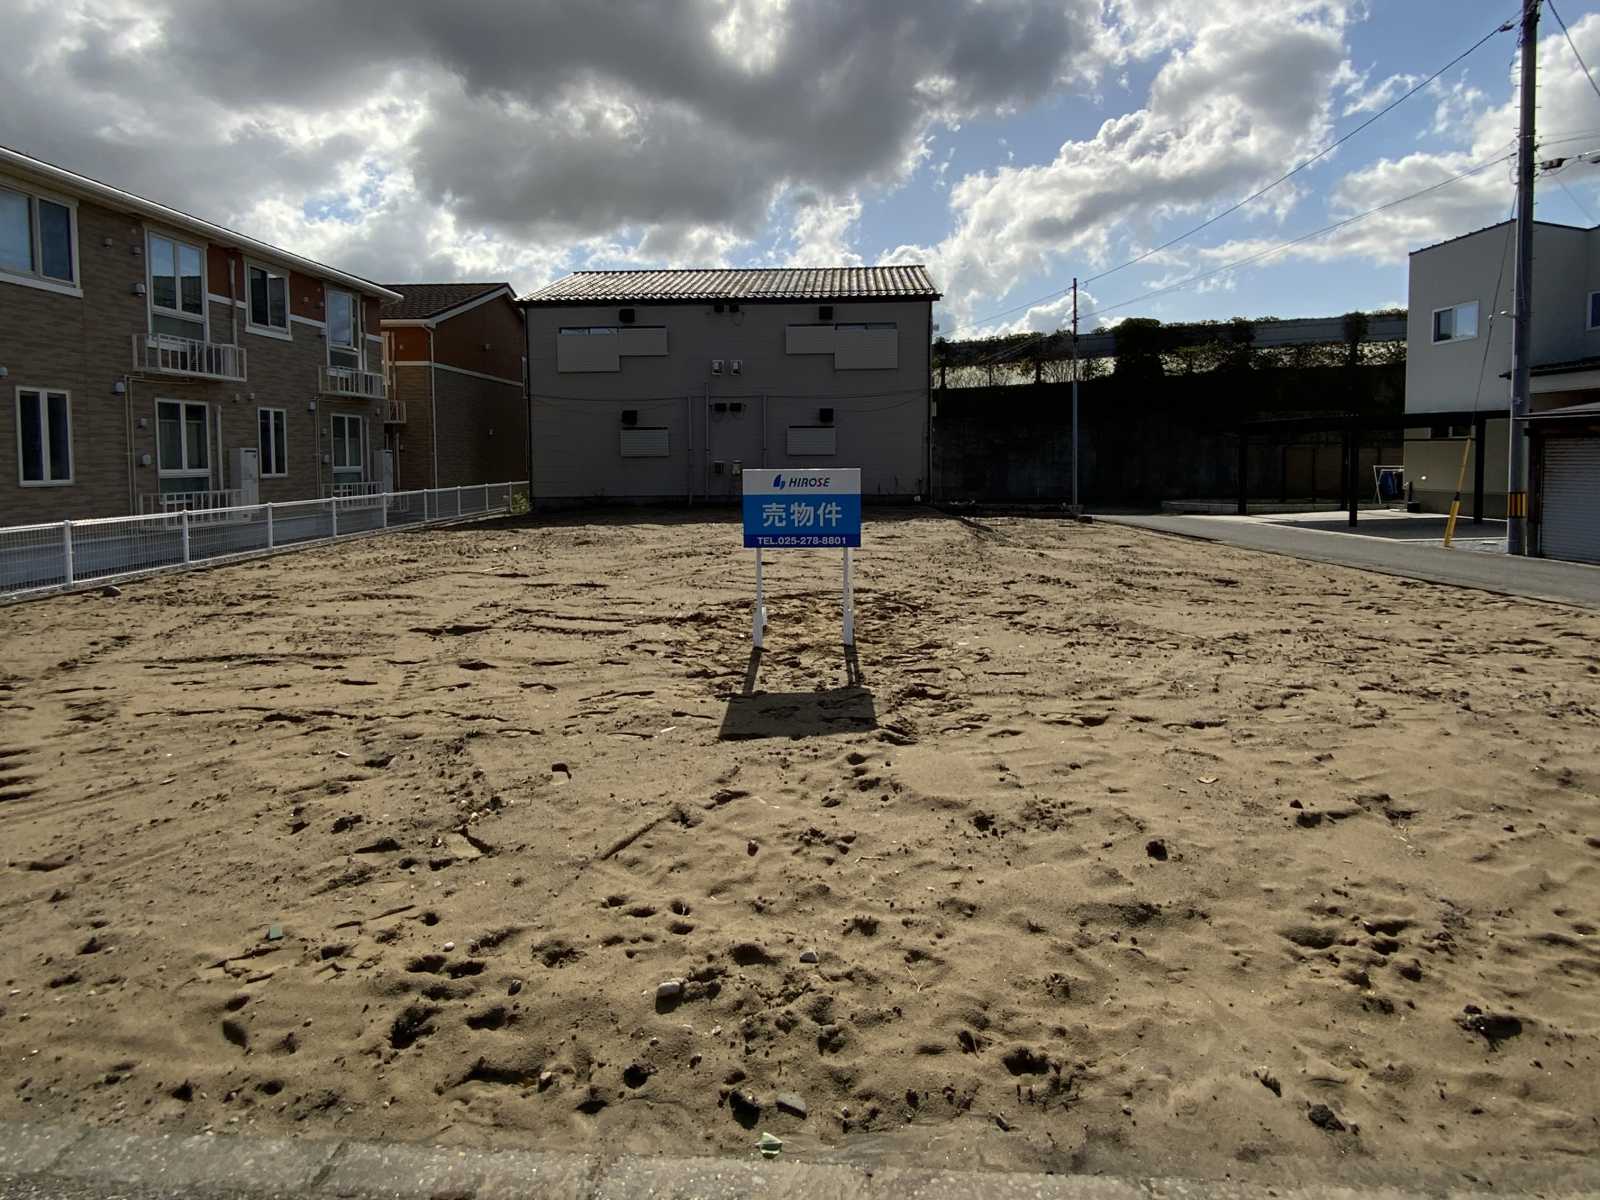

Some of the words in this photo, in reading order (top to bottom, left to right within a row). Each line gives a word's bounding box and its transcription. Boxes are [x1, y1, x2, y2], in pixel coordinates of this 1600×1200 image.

[788, 477, 831, 488] HIROSE
[762, 502, 842, 527] 売物件
[757, 536, 846, 545] TEL.025-278-8801
